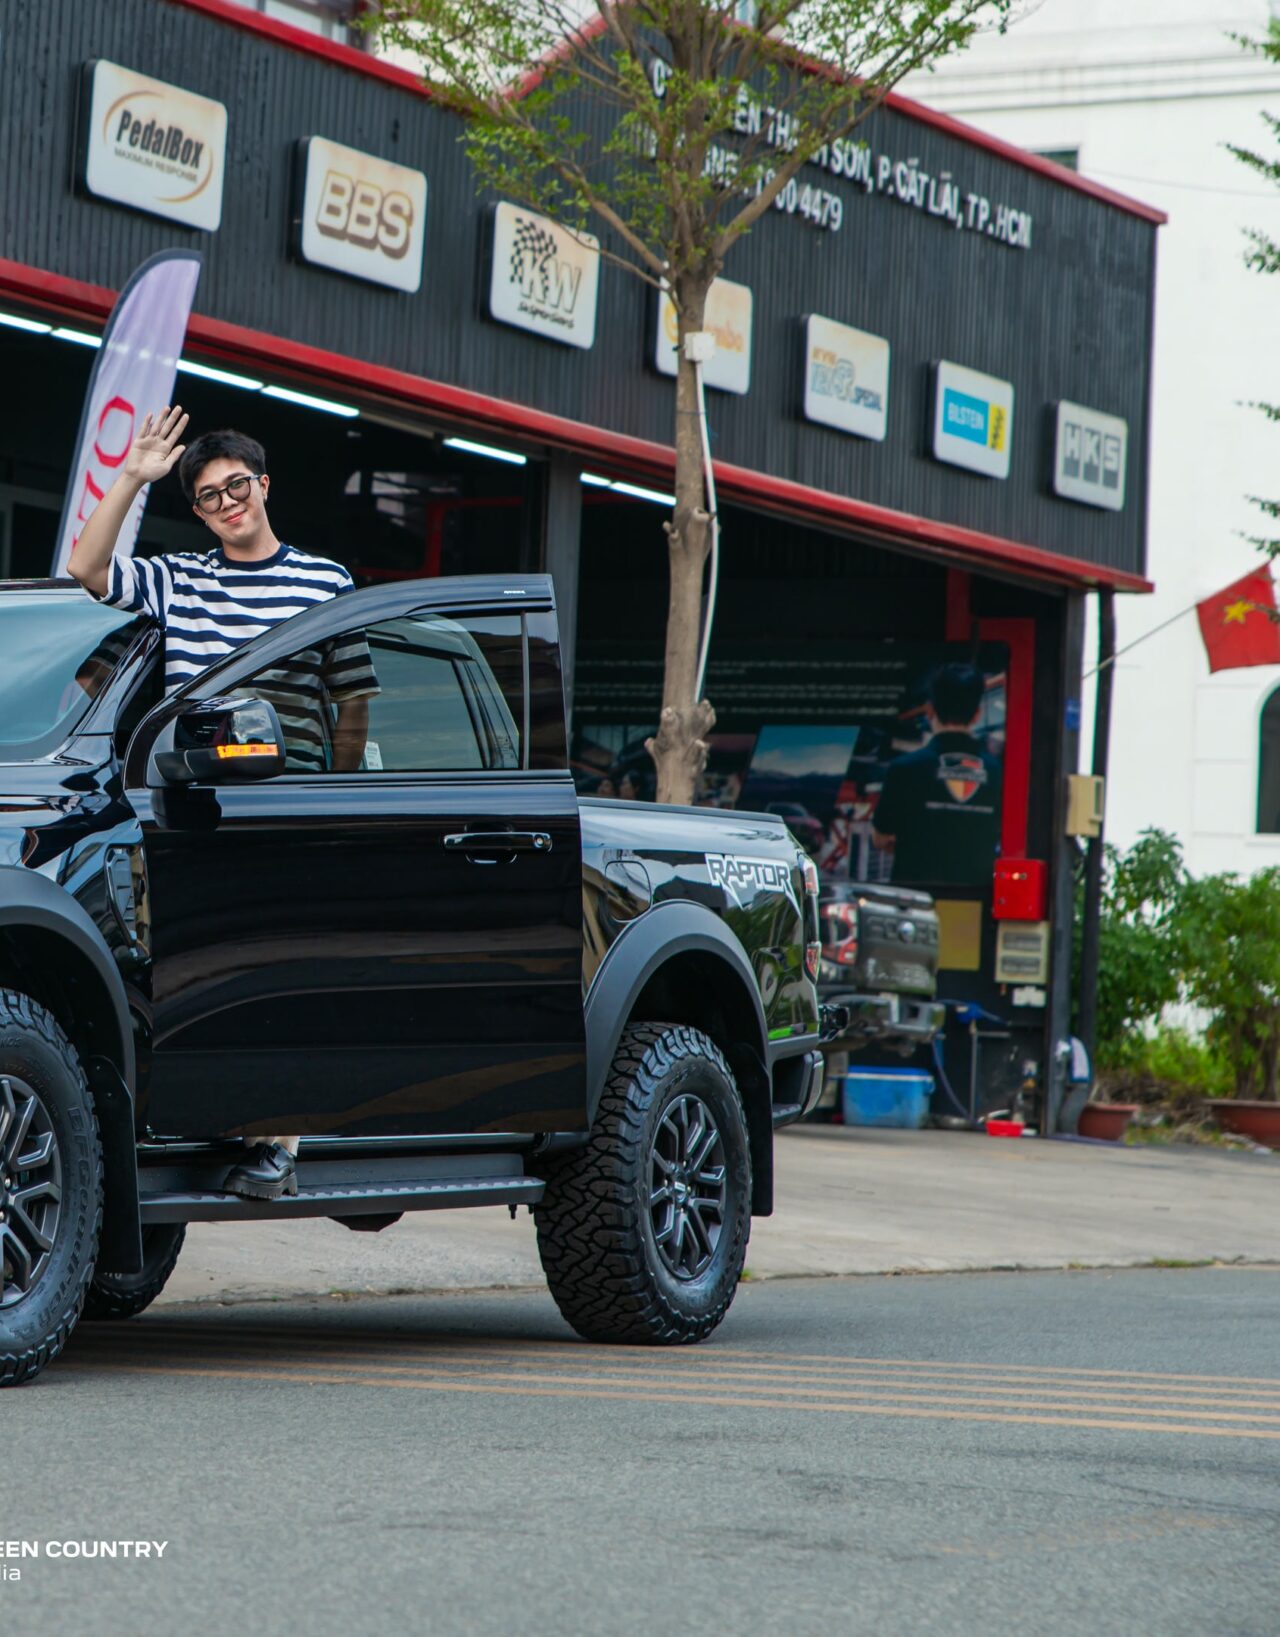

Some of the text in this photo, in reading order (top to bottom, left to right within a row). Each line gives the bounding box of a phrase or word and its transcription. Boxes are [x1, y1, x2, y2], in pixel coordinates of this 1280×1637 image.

[116, 109, 204, 169] PedalBox
[316, 169, 414, 260] BBS
[799, 183, 844, 232] 4479
[519, 248, 581, 314] KW
[1063, 421, 1120, 476] HKS
[705, 853, 796, 905] RAPTOR
